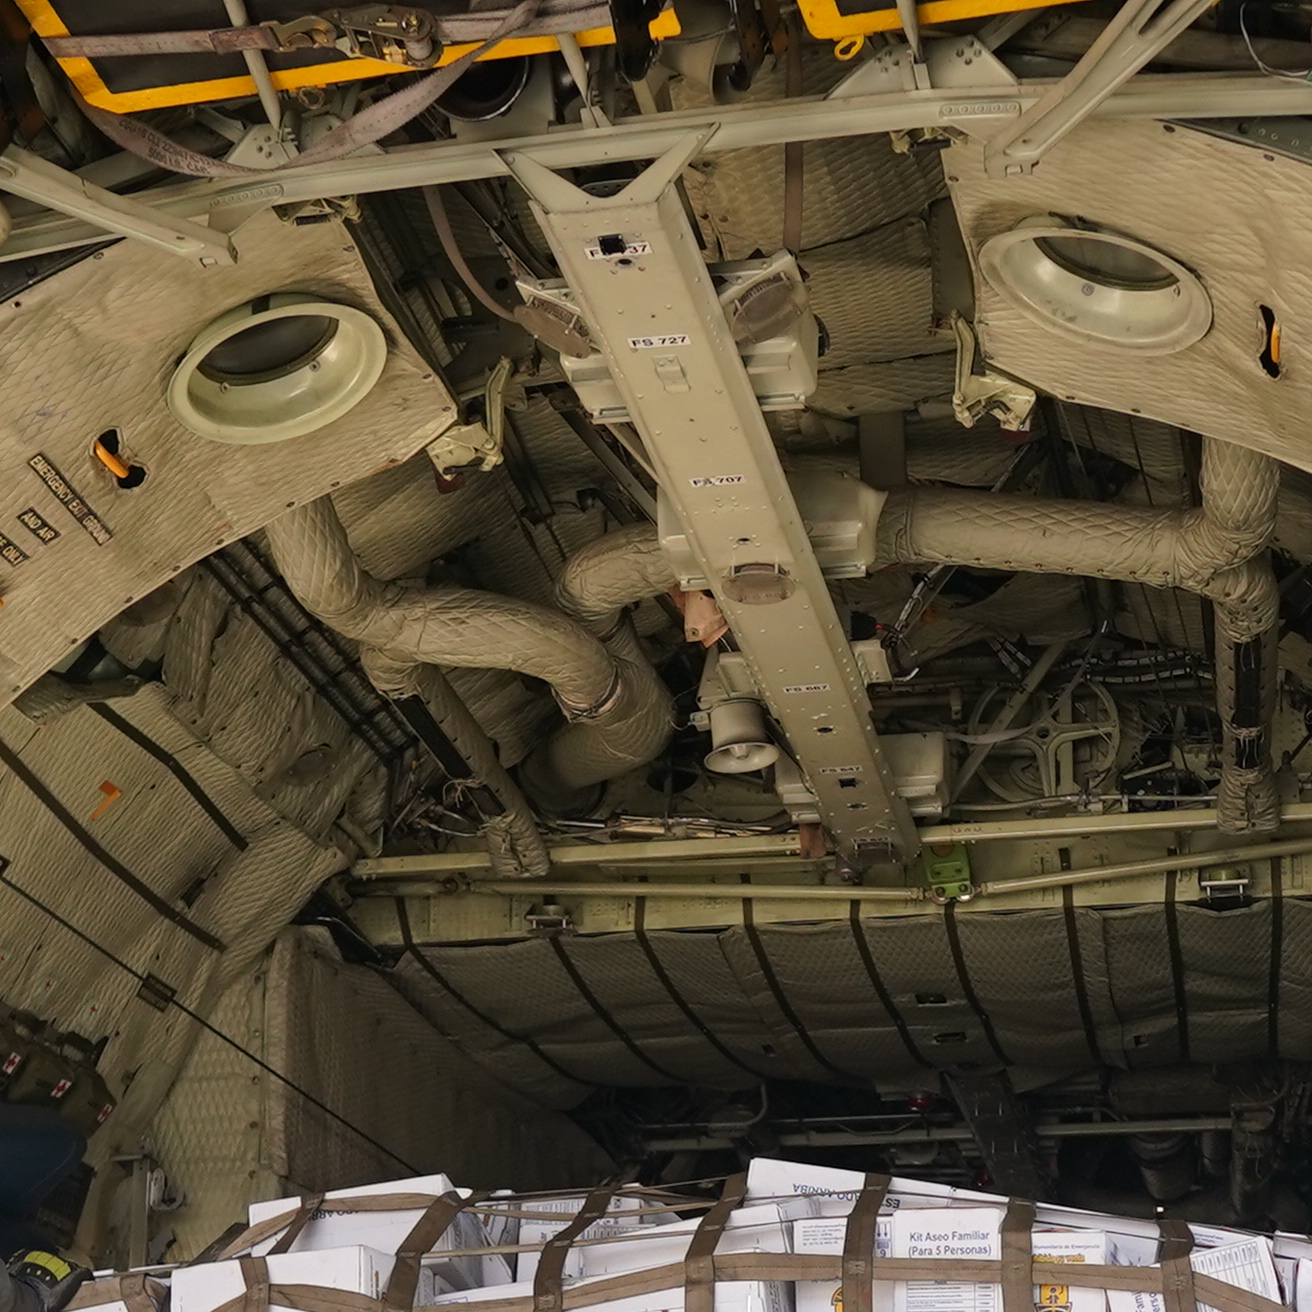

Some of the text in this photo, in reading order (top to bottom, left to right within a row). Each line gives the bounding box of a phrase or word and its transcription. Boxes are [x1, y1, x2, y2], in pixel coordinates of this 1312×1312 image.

[631, 335, 687, 348] FS 727
[29, 455, 75, 502] EMERGENCY
[68, 499, 86, 518] EXIT
[714, 475, 743, 485] 707
[20, 511, 56, 541] AND AIR
[3, 545, 25, 567] ONLY
[908, 1231, 990, 1242] Kit Aseo Familiar
[908, 1244, 992, 1257] (Para 5 Personas)
